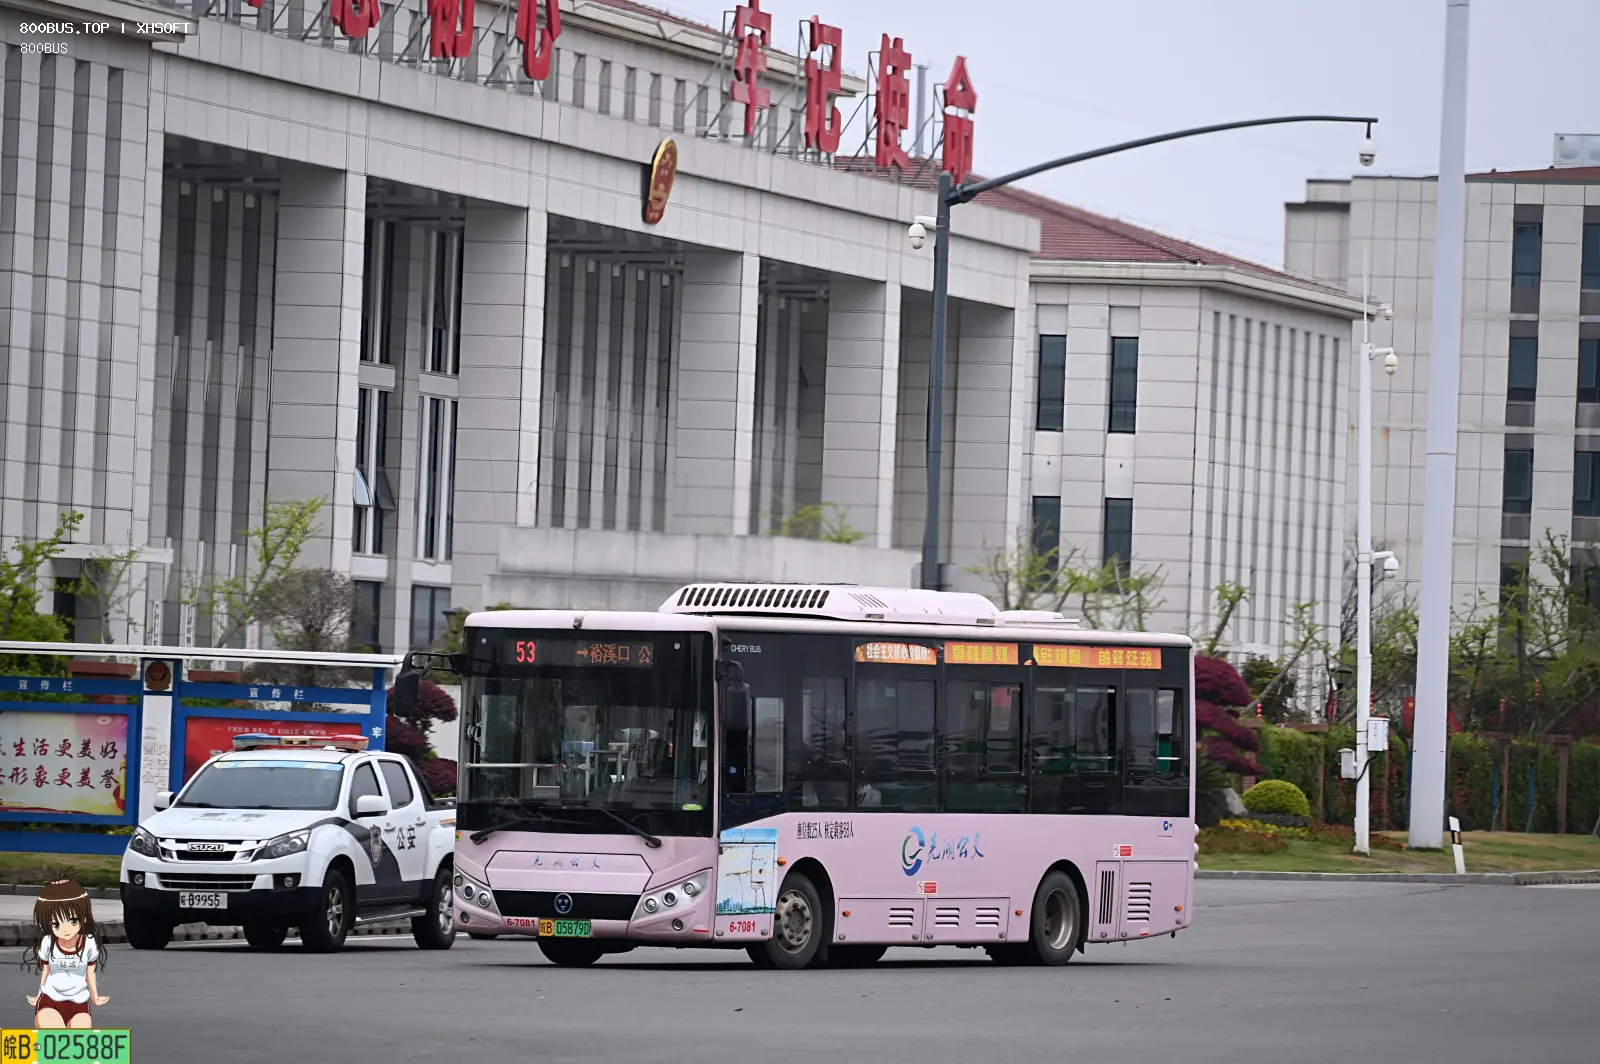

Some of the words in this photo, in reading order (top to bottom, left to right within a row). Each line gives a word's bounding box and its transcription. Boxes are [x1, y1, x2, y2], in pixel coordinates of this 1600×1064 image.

[516, 641, 536, 663] 53
[589, 643, 630, 664] 裕溪口
[731, 644, 750, 653] CHERY
[749, 645, 762, 653] BUS
[18, 680, 73, 692] 宣传栏
[249, 687, 304, 700] 宣传栏
[397, 826, 416, 850] 公安
[507, 919, 535, 928] 6-7081
[729, 921, 756, 933] 6-7081
